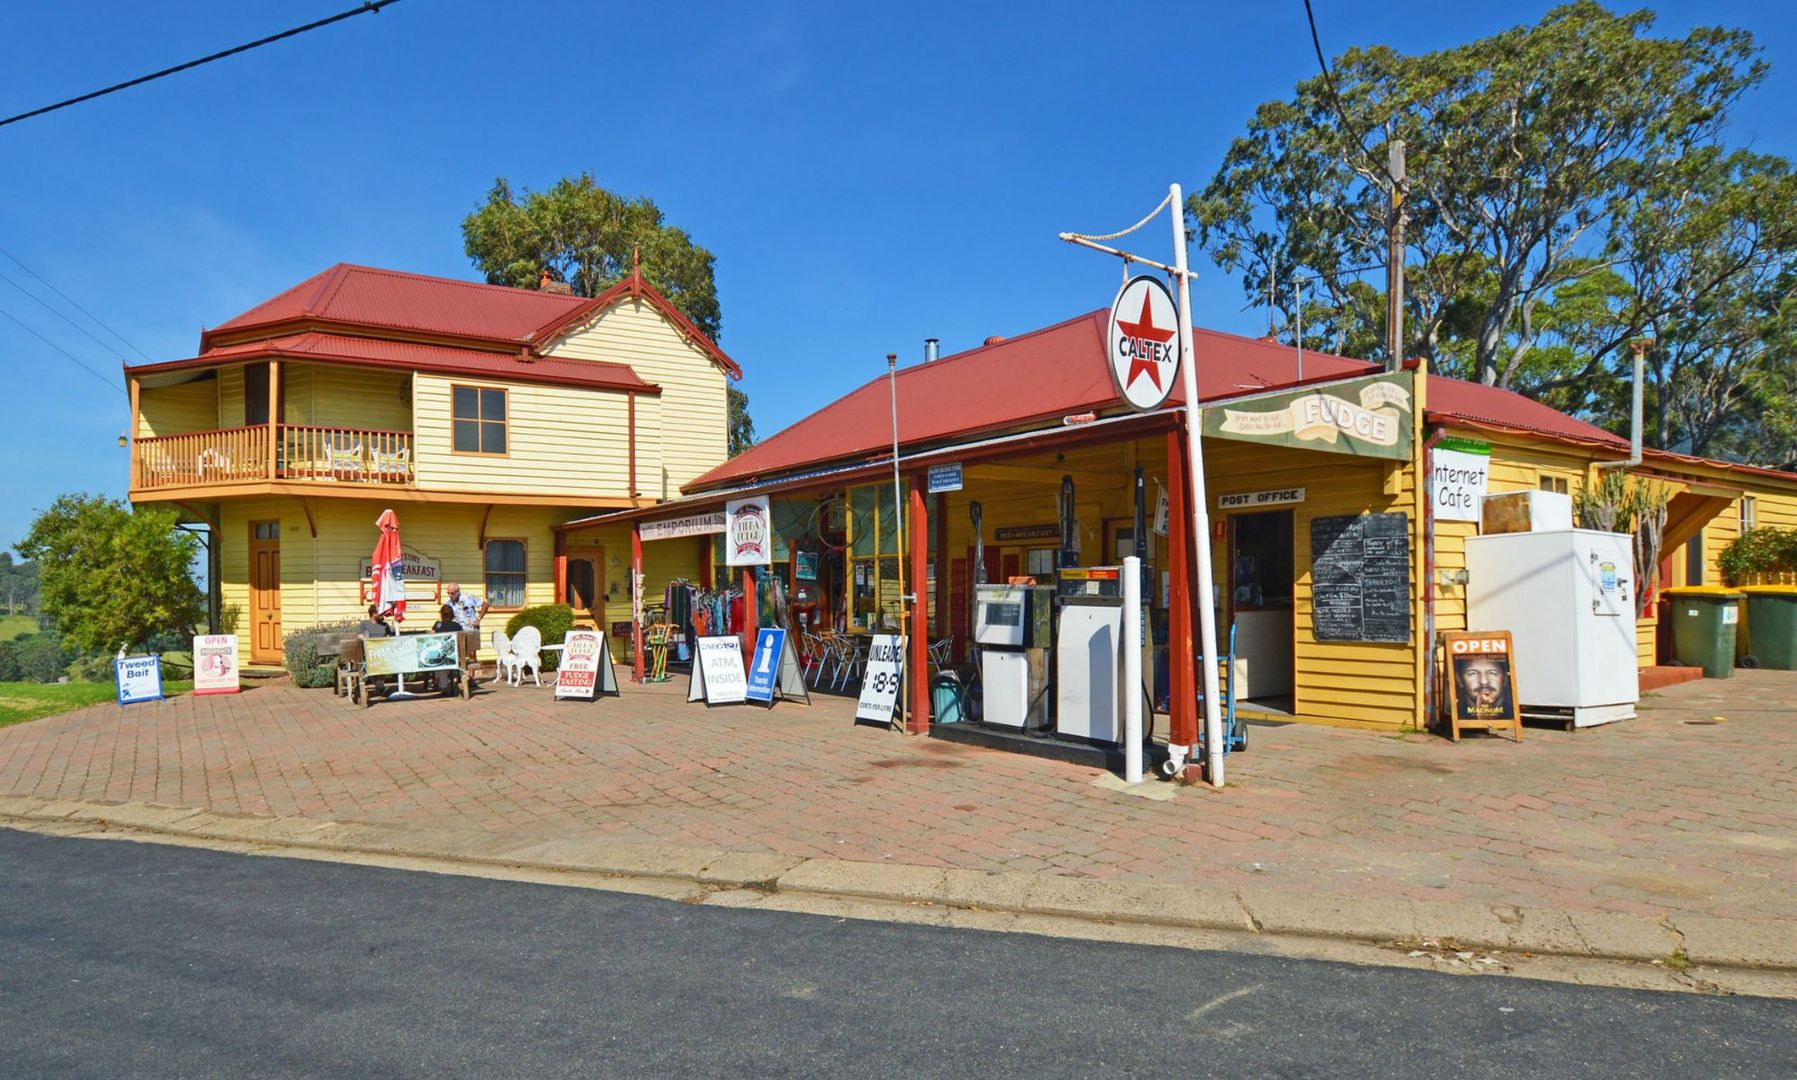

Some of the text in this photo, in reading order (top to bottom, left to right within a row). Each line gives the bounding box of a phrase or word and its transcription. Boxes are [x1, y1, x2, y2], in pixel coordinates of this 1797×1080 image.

[1119, 336, 1173, 363] CALTEX
[1304, 397, 1386, 441] FUDGE
[1435, 464, 1485, 485] nternet
[1222, 490, 1298, 506] POST OFFICE
[1439, 486, 1471, 508] Cafe
[657, 516, 711, 536] EMPORIUM
[401, 565, 435, 577] EAKFAST
[205, 636, 228, 645] OPEN
[1452, 640, 1507, 653] OPEN
[368, 647, 392, 660] Fresh
[119, 659, 155, 669] Tweed
[127, 670, 149, 678] Bait
[707, 673, 742, 684] INSIDE
[860, 701, 872, 709] CENTS
[1467, 706, 1504, 715] MAGNUM
